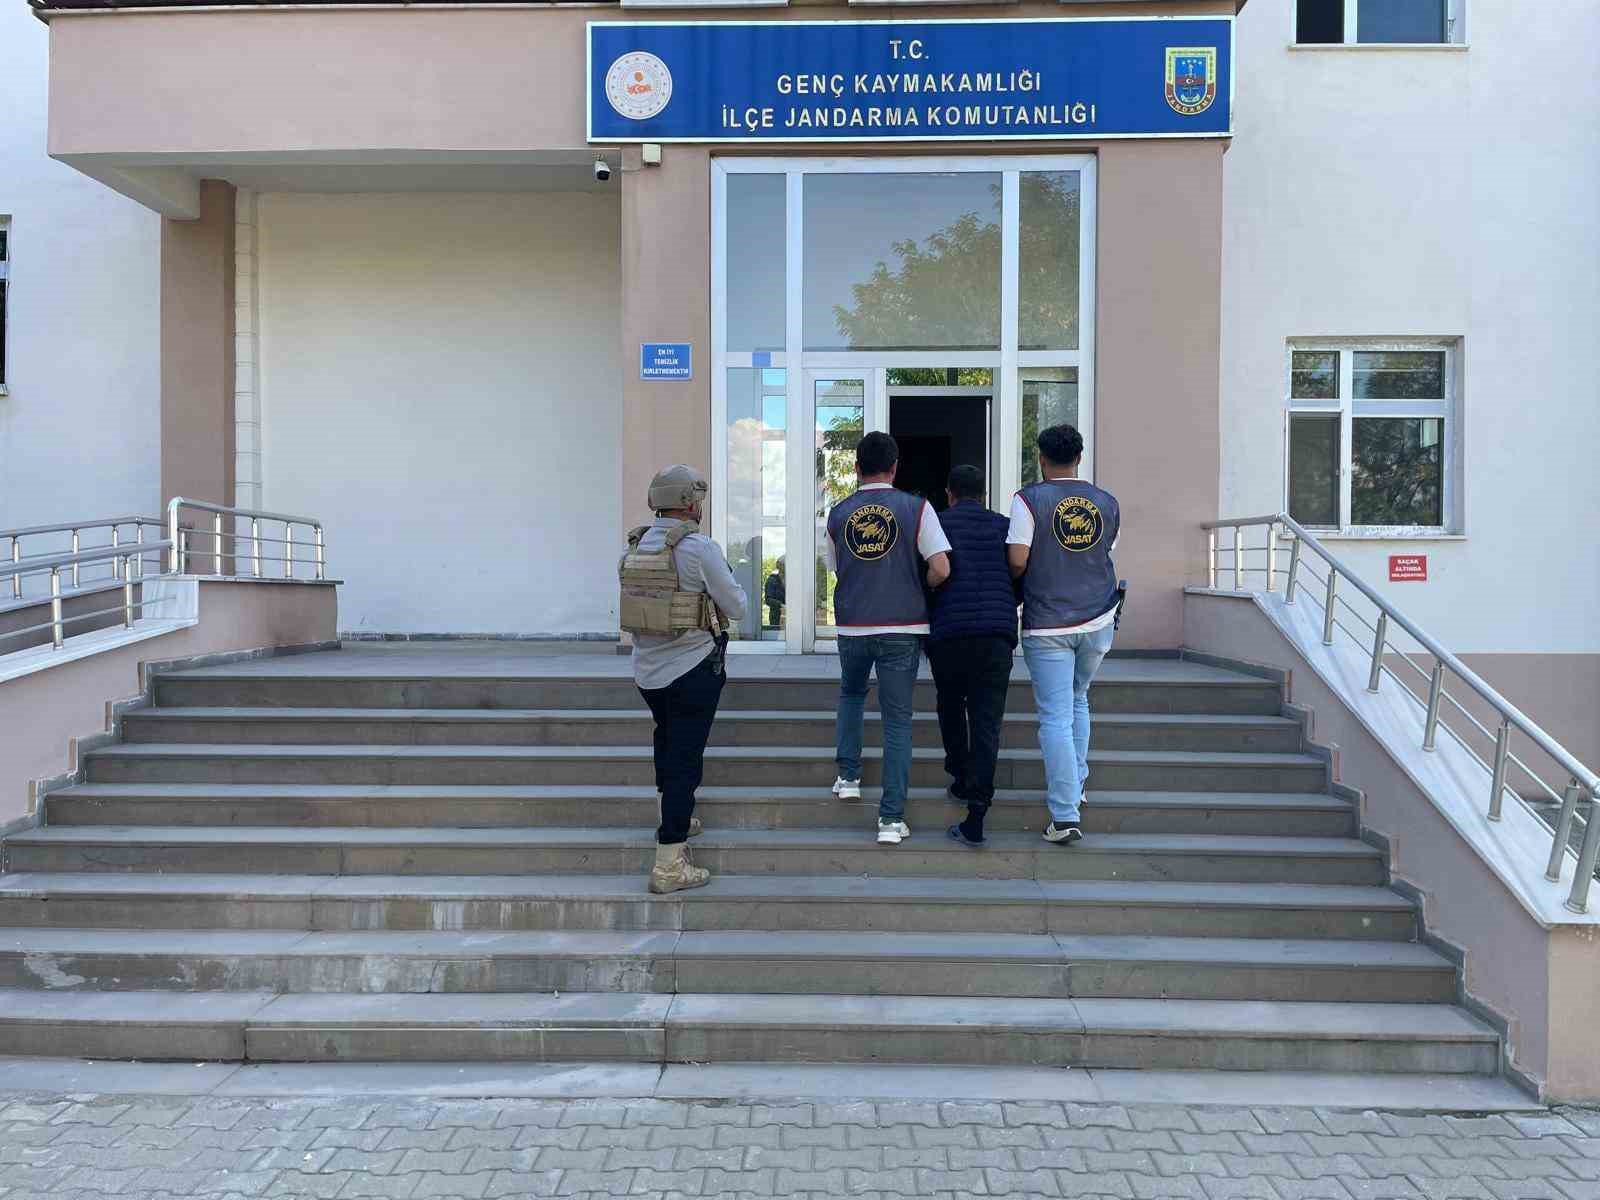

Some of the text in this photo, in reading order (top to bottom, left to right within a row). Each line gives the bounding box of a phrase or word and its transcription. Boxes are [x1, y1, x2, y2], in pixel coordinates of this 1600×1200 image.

[889, 40, 929, 59] T.C.
[777, 69, 1041, 98] GENÇ KAYMAKAMLIĞI
[721, 102, 1096, 132] İLÇE JANDARMA KOMUTANLIĞI
[850, 505, 893, 527] JANDARMA
[1056, 497, 1099, 516] JANDARMA
[856, 542, 886, 554] JASAT
[1063, 534, 1093, 545] JASAT
